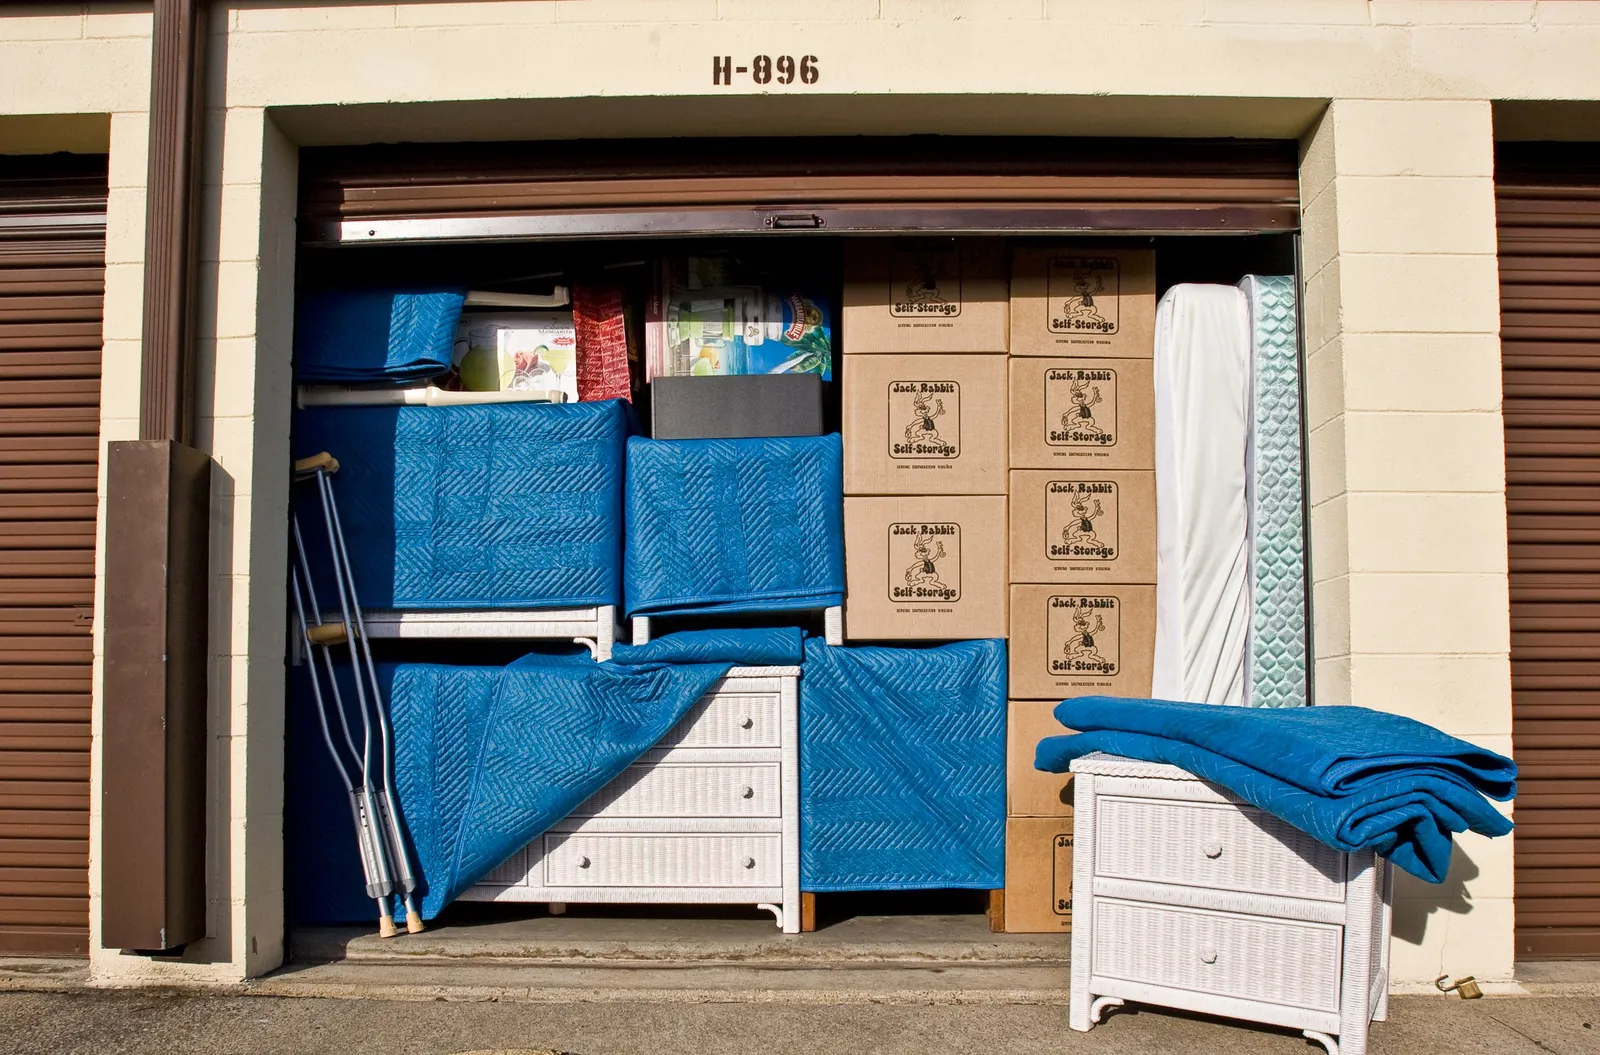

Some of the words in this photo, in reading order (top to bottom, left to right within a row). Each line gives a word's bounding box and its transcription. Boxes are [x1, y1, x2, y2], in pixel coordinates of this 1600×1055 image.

[713, 55, 819, 85] H-896
[894, 302, 957, 315] Self-Storage
[1052, 319, 1115, 333] Self-Storage
[1049, 371, 1073, 381] Jack
[1077, 371, 1111, 381] Rabbit
[893, 382, 917, 393] Jack
[920, 382, 955, 393] Rabbit
[1050, 431, 1113, 444] Self-Storage
[893, 444, 956, 456] Self-Storage
[1050, 483, 1074, 494] Jack
[1078, 483, 1113, 494] Rabbit
[893, 525, 917, 535] Jack
[921, 525, 955, 535] Rabbit
[1051, 545, 1114, 558] Self-Storage
[893, 587, 957, 600] Self-Storage
[1052, 598, 1076, 608] Jack
[1080, 598, 1115, 608] Rabbit
[1052, 660, 1115, 673] Self-Storage
[1058, 837, 1073, 847] Jac
